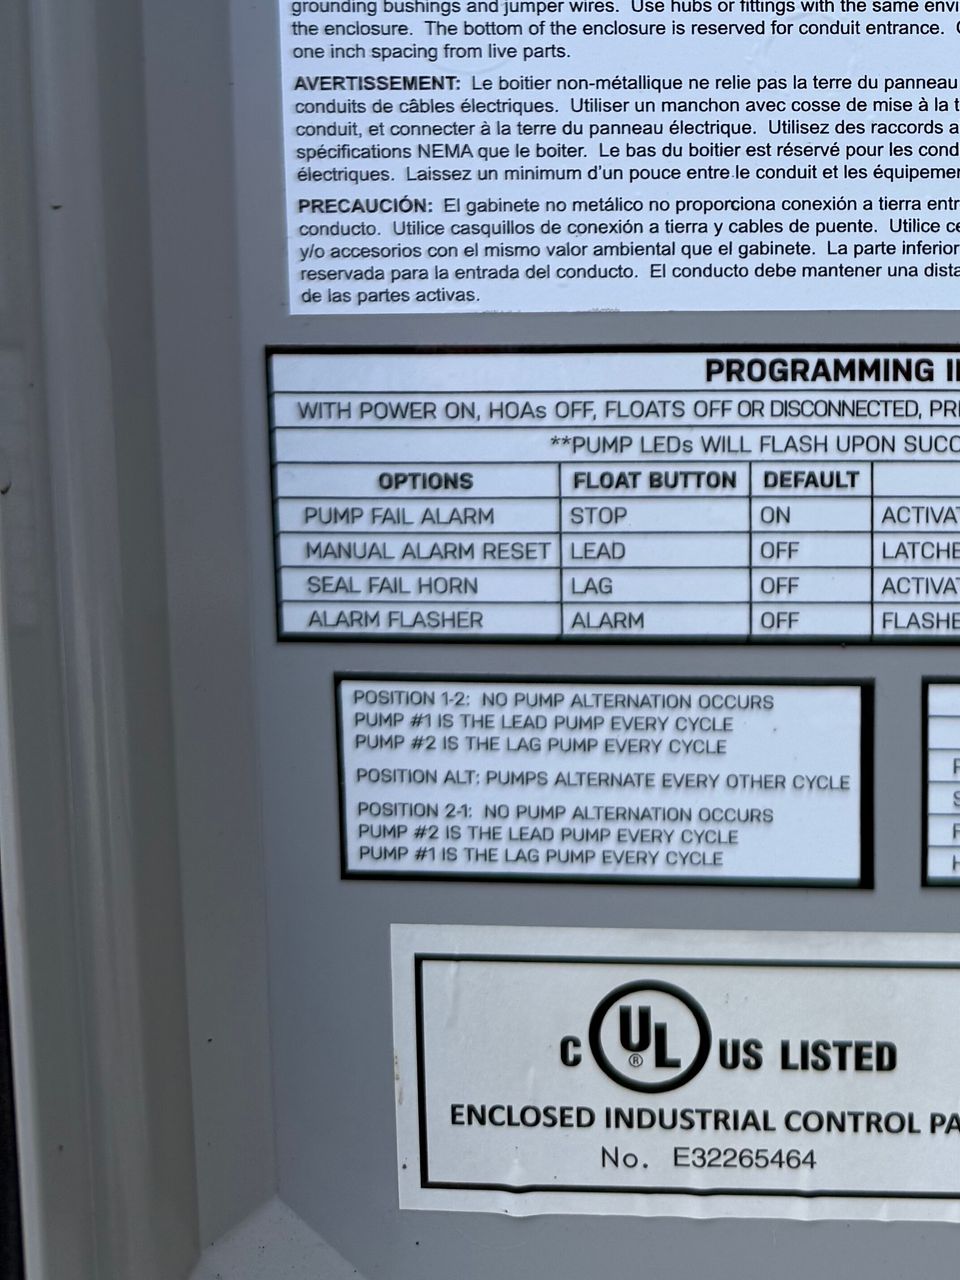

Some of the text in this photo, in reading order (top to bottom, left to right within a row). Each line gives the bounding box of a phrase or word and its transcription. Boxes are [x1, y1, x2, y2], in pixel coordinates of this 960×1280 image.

[293, 74, 683, 94] AVERTISSEMENT: Le boitier non-métallique
[298, 194, 644, 217] PRECAUCIÓN: El gabinete no metálico
[300, 287, 480, 306] de las partes activas.
[705, 358, 934, 383] PROGRAMMING
[378, 472, 474, 490] OPTIONS
[573, 471, 642, 490] FLOAT
[649, 471, 737, 489] BUTTON
[763, 470, 860, 489] DEFAULT
[304, 506, 364, 525] PUMP
[370, 507, 414, 526] FAIL
[420, 507, 495, 525] ALARM
[570, 506, 628, 525] STOP
[760, 506, 791, 524] ON
[353, 689, 774, 710] POSITION 1-2: NO PUMP ALTERNATION OCCURS
[619, 1005, 682, 1069] UL
[719, 1039, 763, 1071] US
[780, 1039, 897, 1072] LISTED
[450, 1103, 596, 1128] ENCLOSED
[605, 1107, 777, 1132] INDUSTRIAL
[784, 1110, 921, 1134] CONTROL
[601, 1146, 817, 1170] No. E32265464
